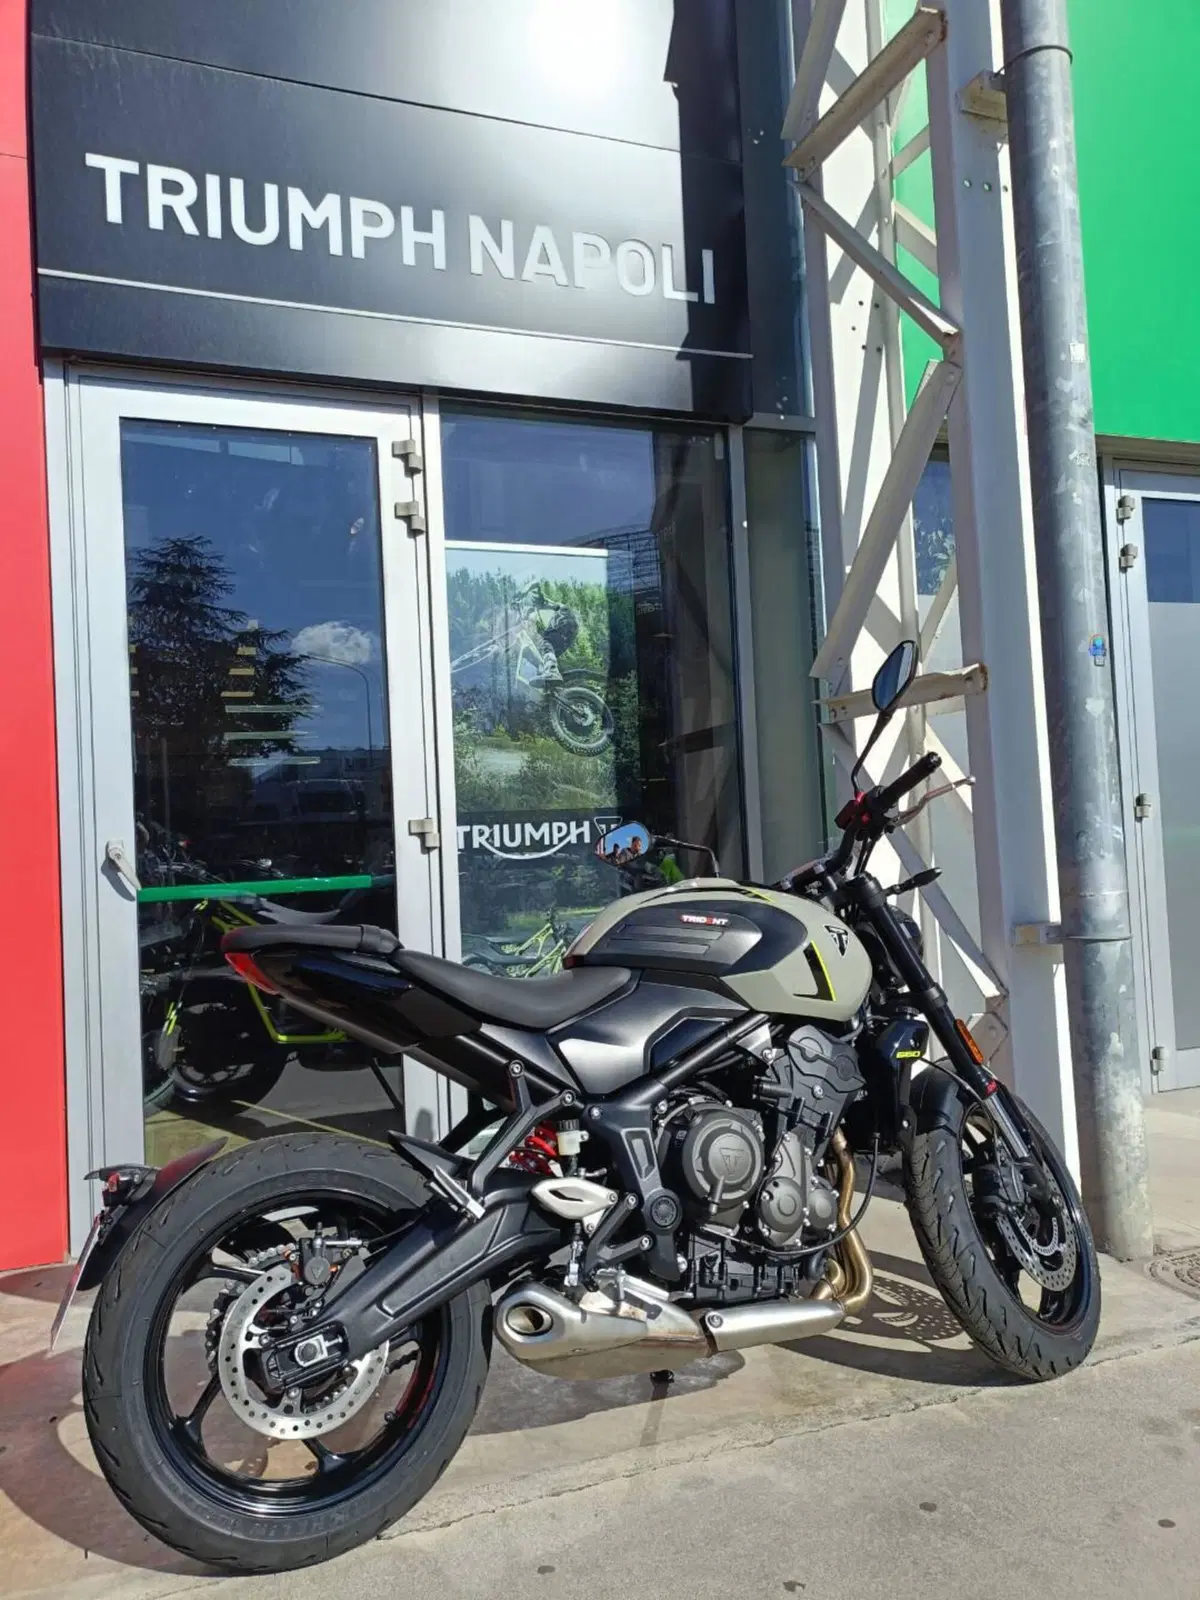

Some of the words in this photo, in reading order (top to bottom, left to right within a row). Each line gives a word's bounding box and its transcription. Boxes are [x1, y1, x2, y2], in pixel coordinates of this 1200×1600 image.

[85, 152, 446, 271] TRIUMPH
[468, 214, 716, 304] NAPOLI
[456, 820, 591, 859] TRIUMPH
[680, 914, 729, 926] TRIDENT
